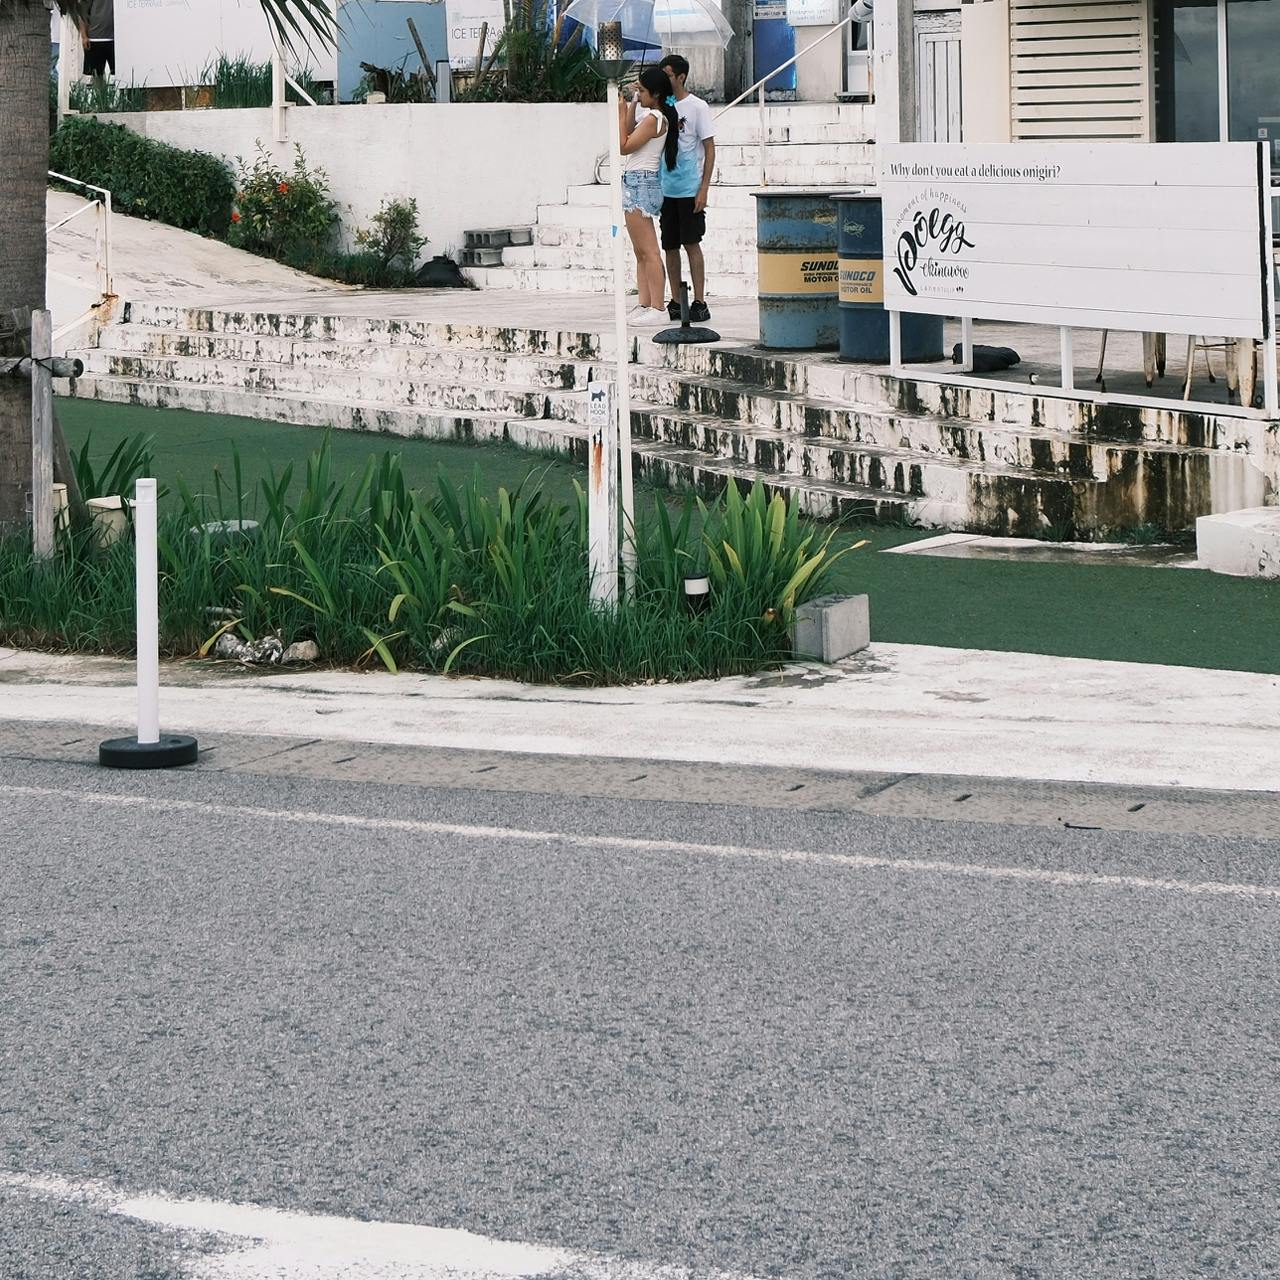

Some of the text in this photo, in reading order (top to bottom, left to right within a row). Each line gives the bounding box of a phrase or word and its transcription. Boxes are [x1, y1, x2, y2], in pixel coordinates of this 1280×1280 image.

[451, 28, 466, 39] ICE
[891, 162, 910, 178] Why
[936, 166, 953, 179] you
[954, 165, 969, 176] eat
[971, 167, 977, 177] a
[978, 163, 1021, 178] delicious
[1023, 164, 1061, 182] onigiri?
[896, 195, 920, 228] moment
[921, 188, 928, 201] of
[929, 187, 967, 214] happiness
[860, 286, 873, 294] OIL
